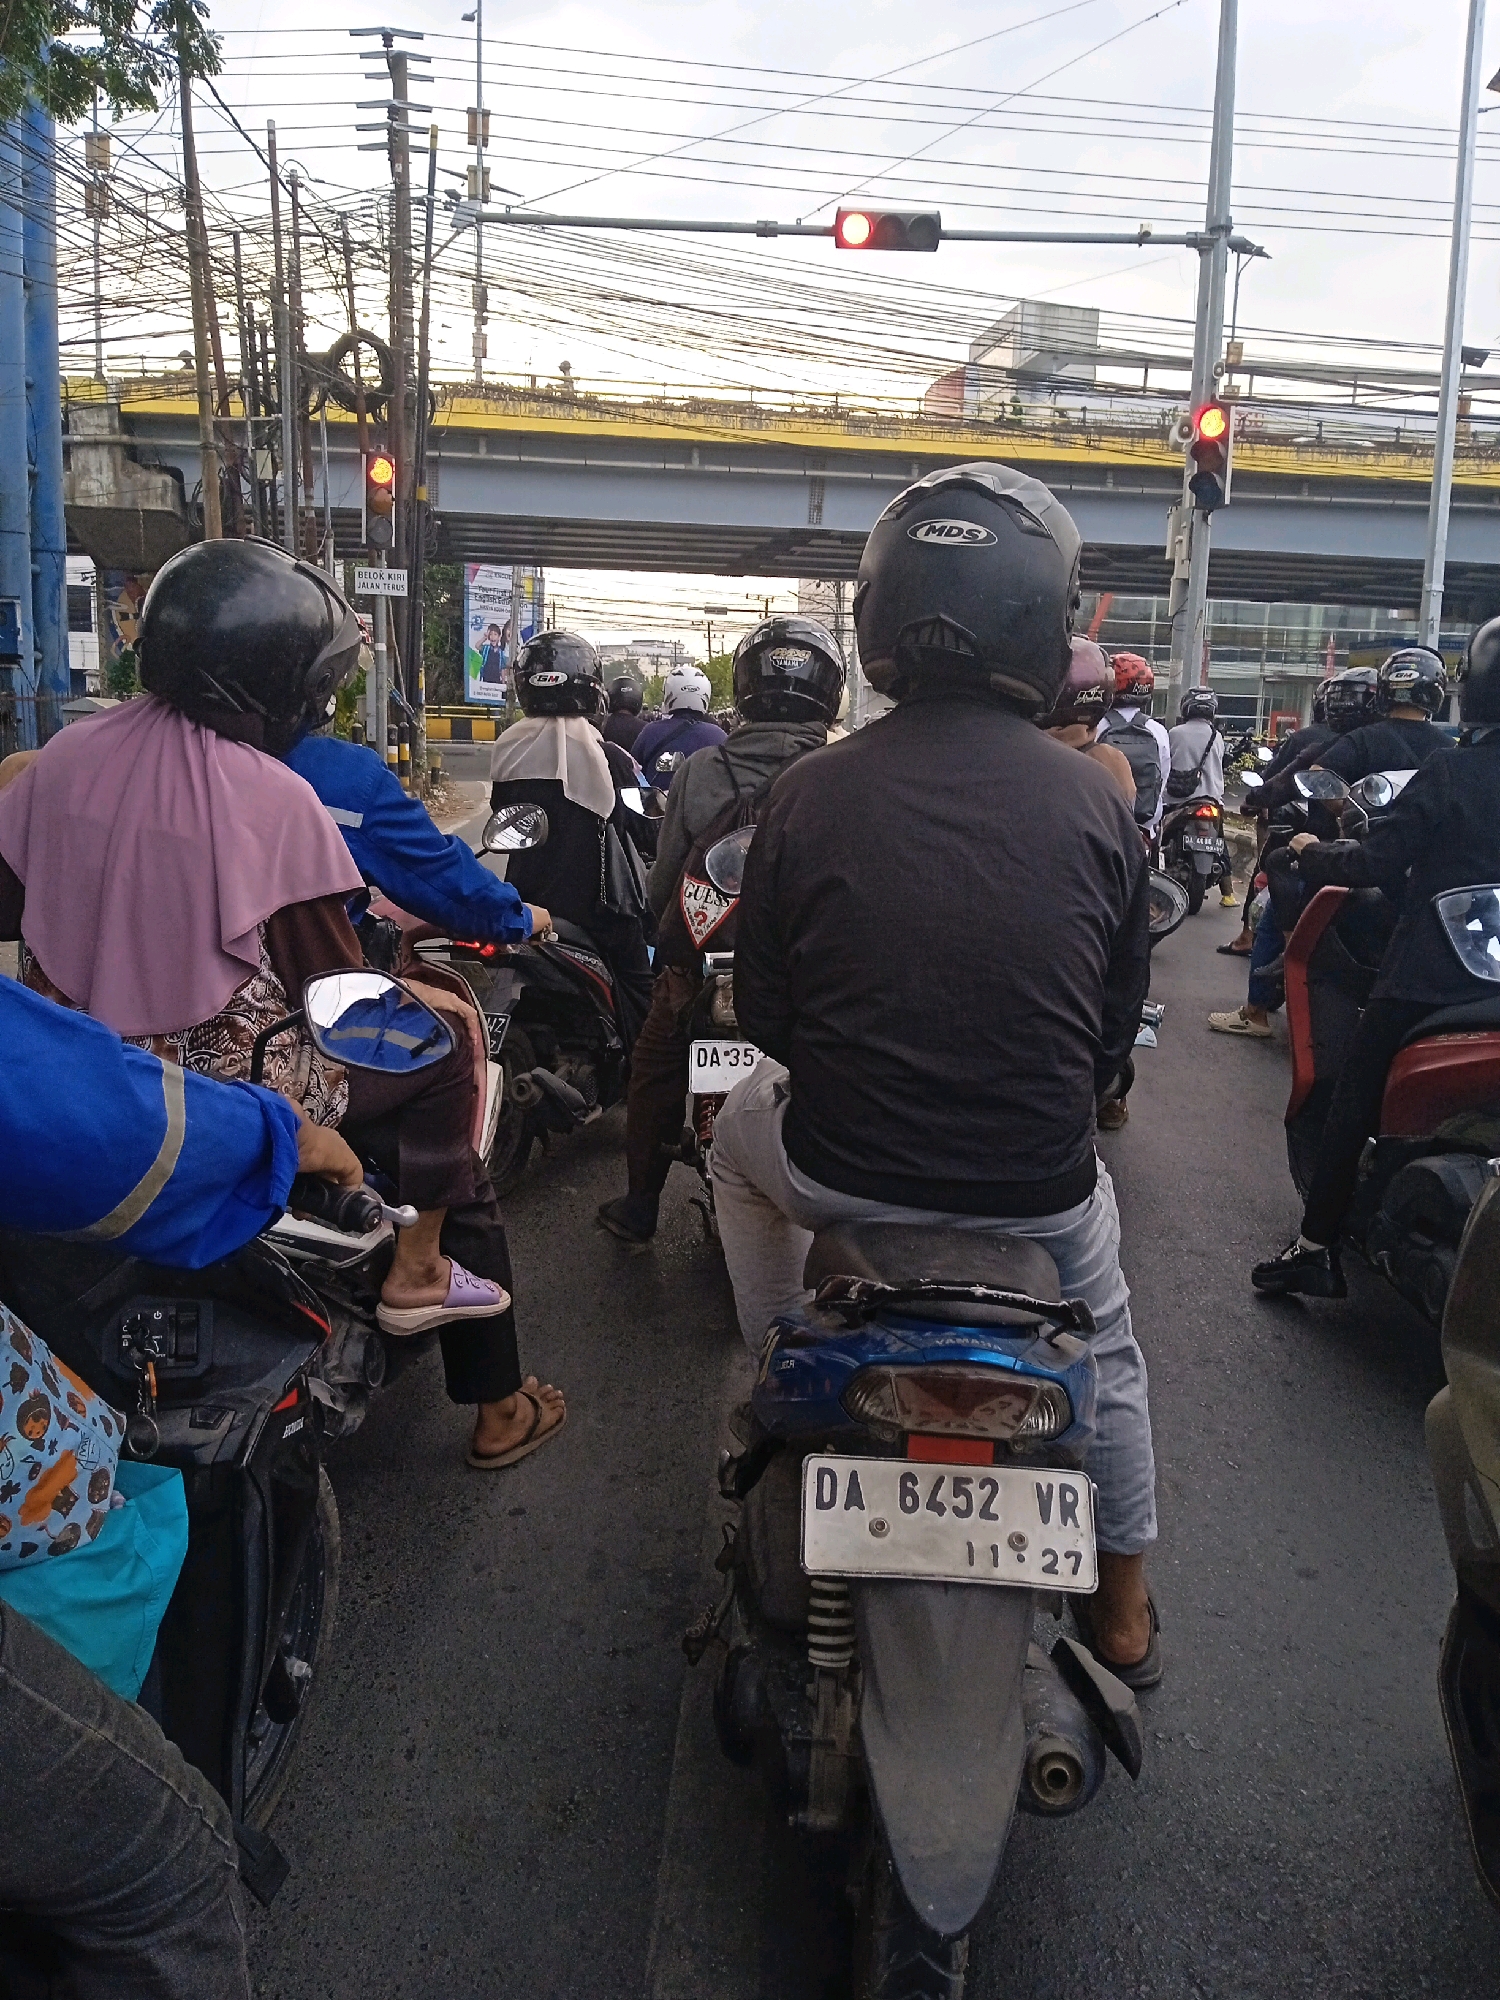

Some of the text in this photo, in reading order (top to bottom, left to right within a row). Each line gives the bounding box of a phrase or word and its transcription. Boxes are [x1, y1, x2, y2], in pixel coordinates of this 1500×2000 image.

[924, 525, 982, 540] MDS
[358, 571, 405, 581] BELOK KIRI
[358, 582, 405, 592] JALAN TERUS
[776, 659, 799, 667] YAMAHA
[536, 675, 559, 683] GM
[684, 882, 730, 907] GUESS
[697, 1048, 767, 1067] DA 35
[815, 1467, 1081, 1529] DA 6452 VR
